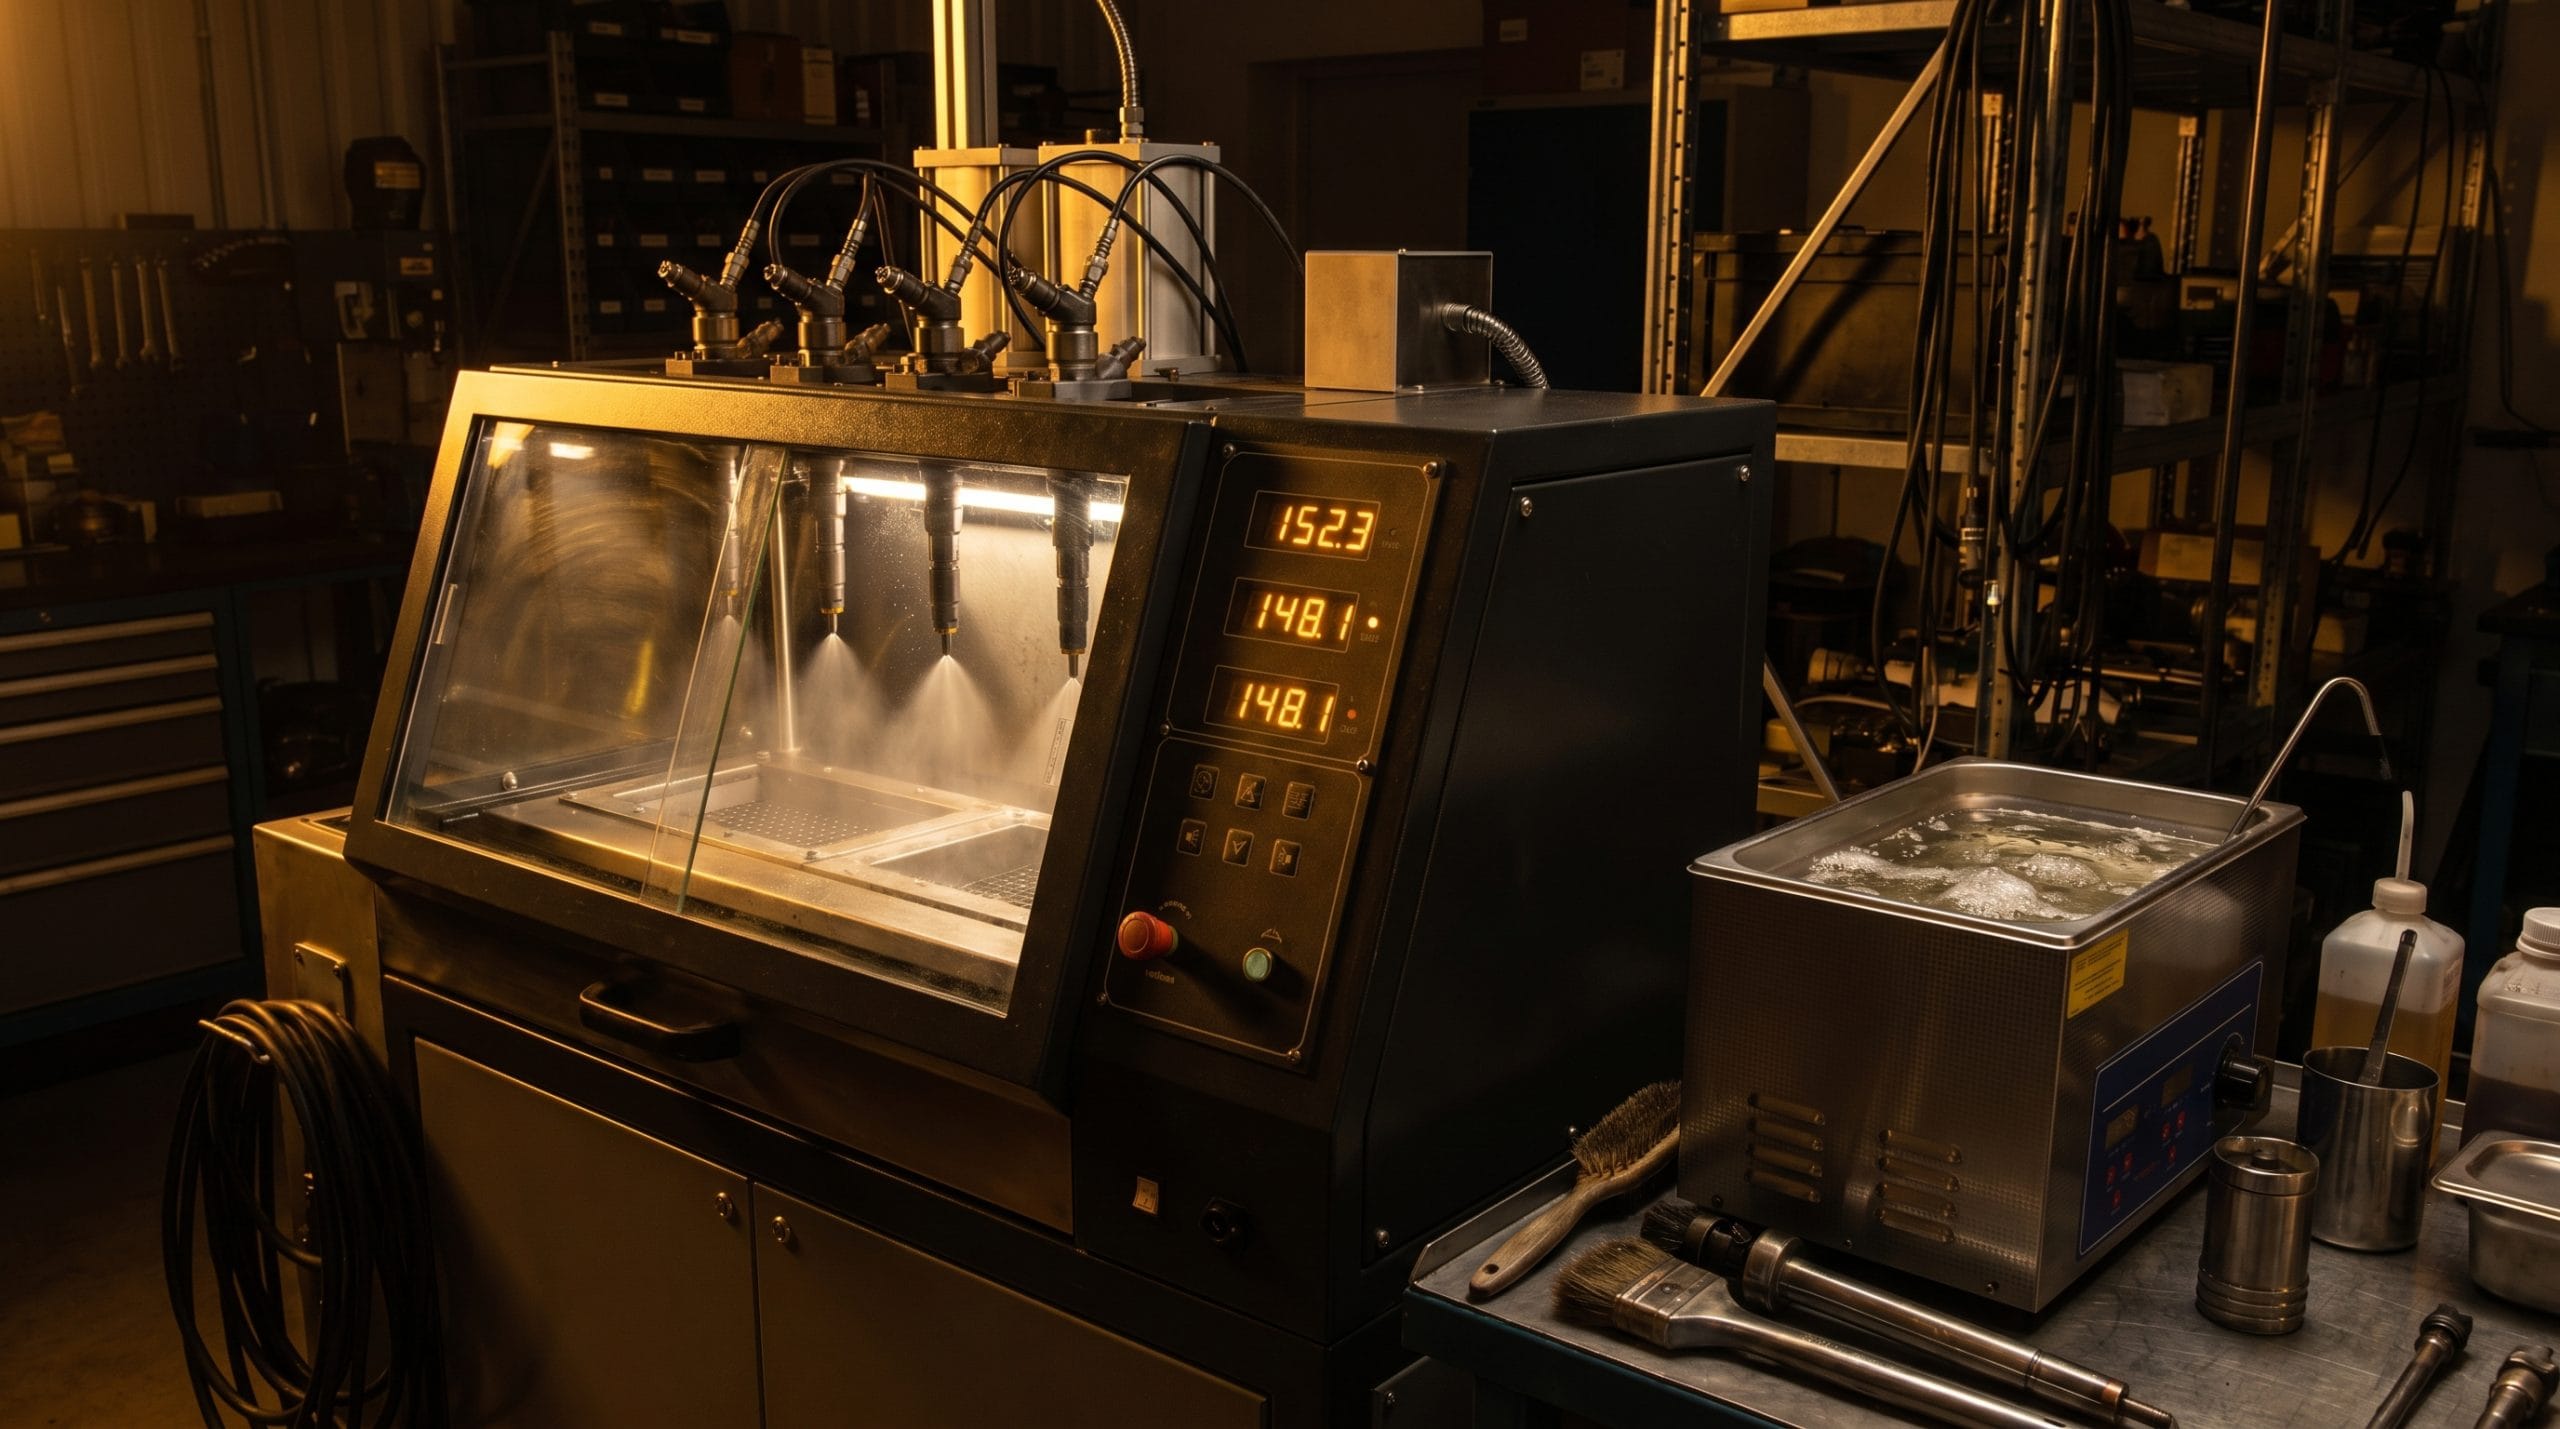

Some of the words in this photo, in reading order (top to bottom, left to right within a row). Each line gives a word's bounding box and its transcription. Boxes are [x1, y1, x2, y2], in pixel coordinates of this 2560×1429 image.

[1278, 505, 1374, 551] 152.3
[1257, 593, 1354, 640] 148.1
[1238, 683, 1335, 733] 148.1
